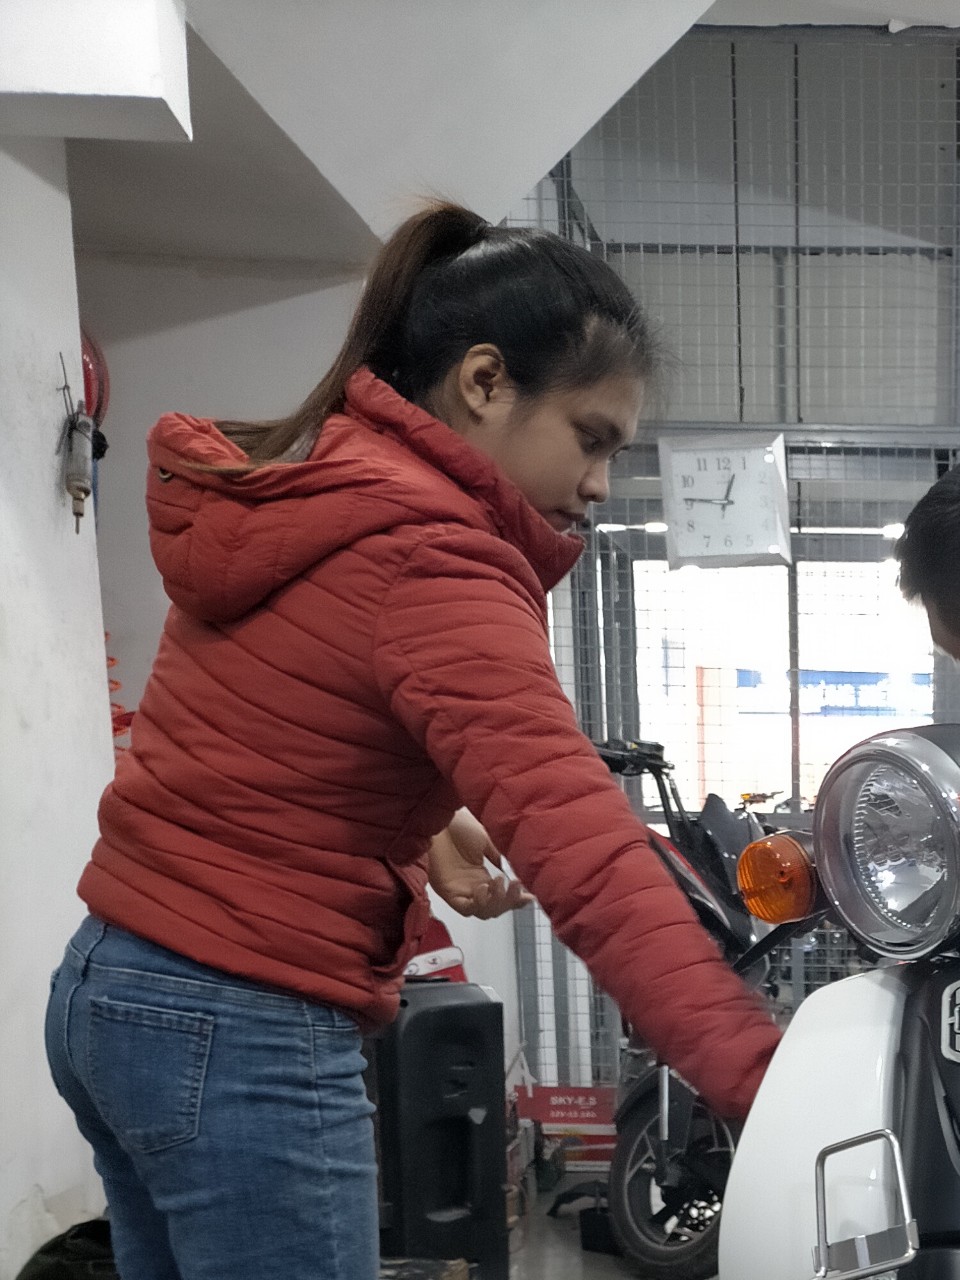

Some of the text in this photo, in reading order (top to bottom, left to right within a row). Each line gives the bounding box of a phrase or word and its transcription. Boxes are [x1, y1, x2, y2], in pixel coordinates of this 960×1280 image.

[696, 456, 747, 472] 11 12 1
[681, 474, 695, 488] 10
[686, 519, 696, 533] 8
[703, 535, 711, 548] 7
[724, 535, 733, 548] 6
